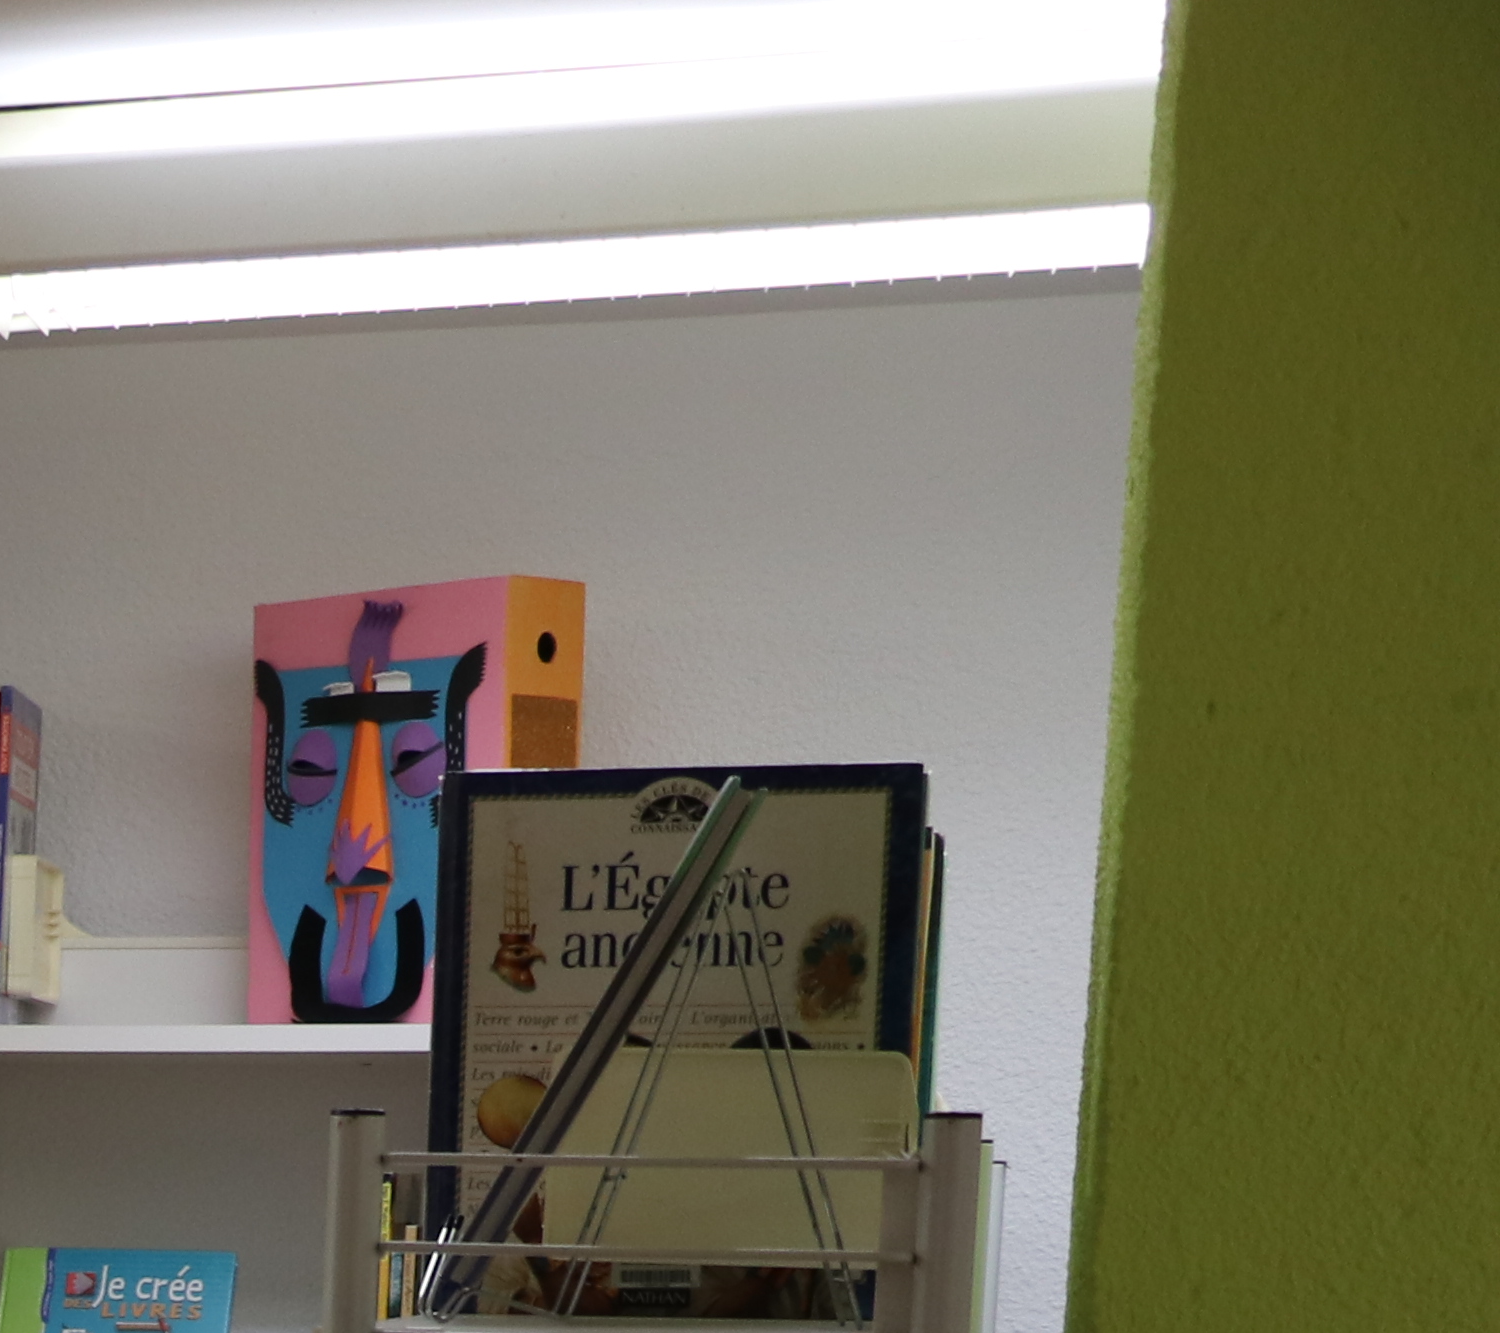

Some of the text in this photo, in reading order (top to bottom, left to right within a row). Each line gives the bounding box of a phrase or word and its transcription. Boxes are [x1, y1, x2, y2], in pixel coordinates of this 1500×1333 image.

[92, 1264, 205, 1309] Je crée
[622, 1290, 686, 1304] NATHAN
[100, 1302, 204, 1320] LIVRES
